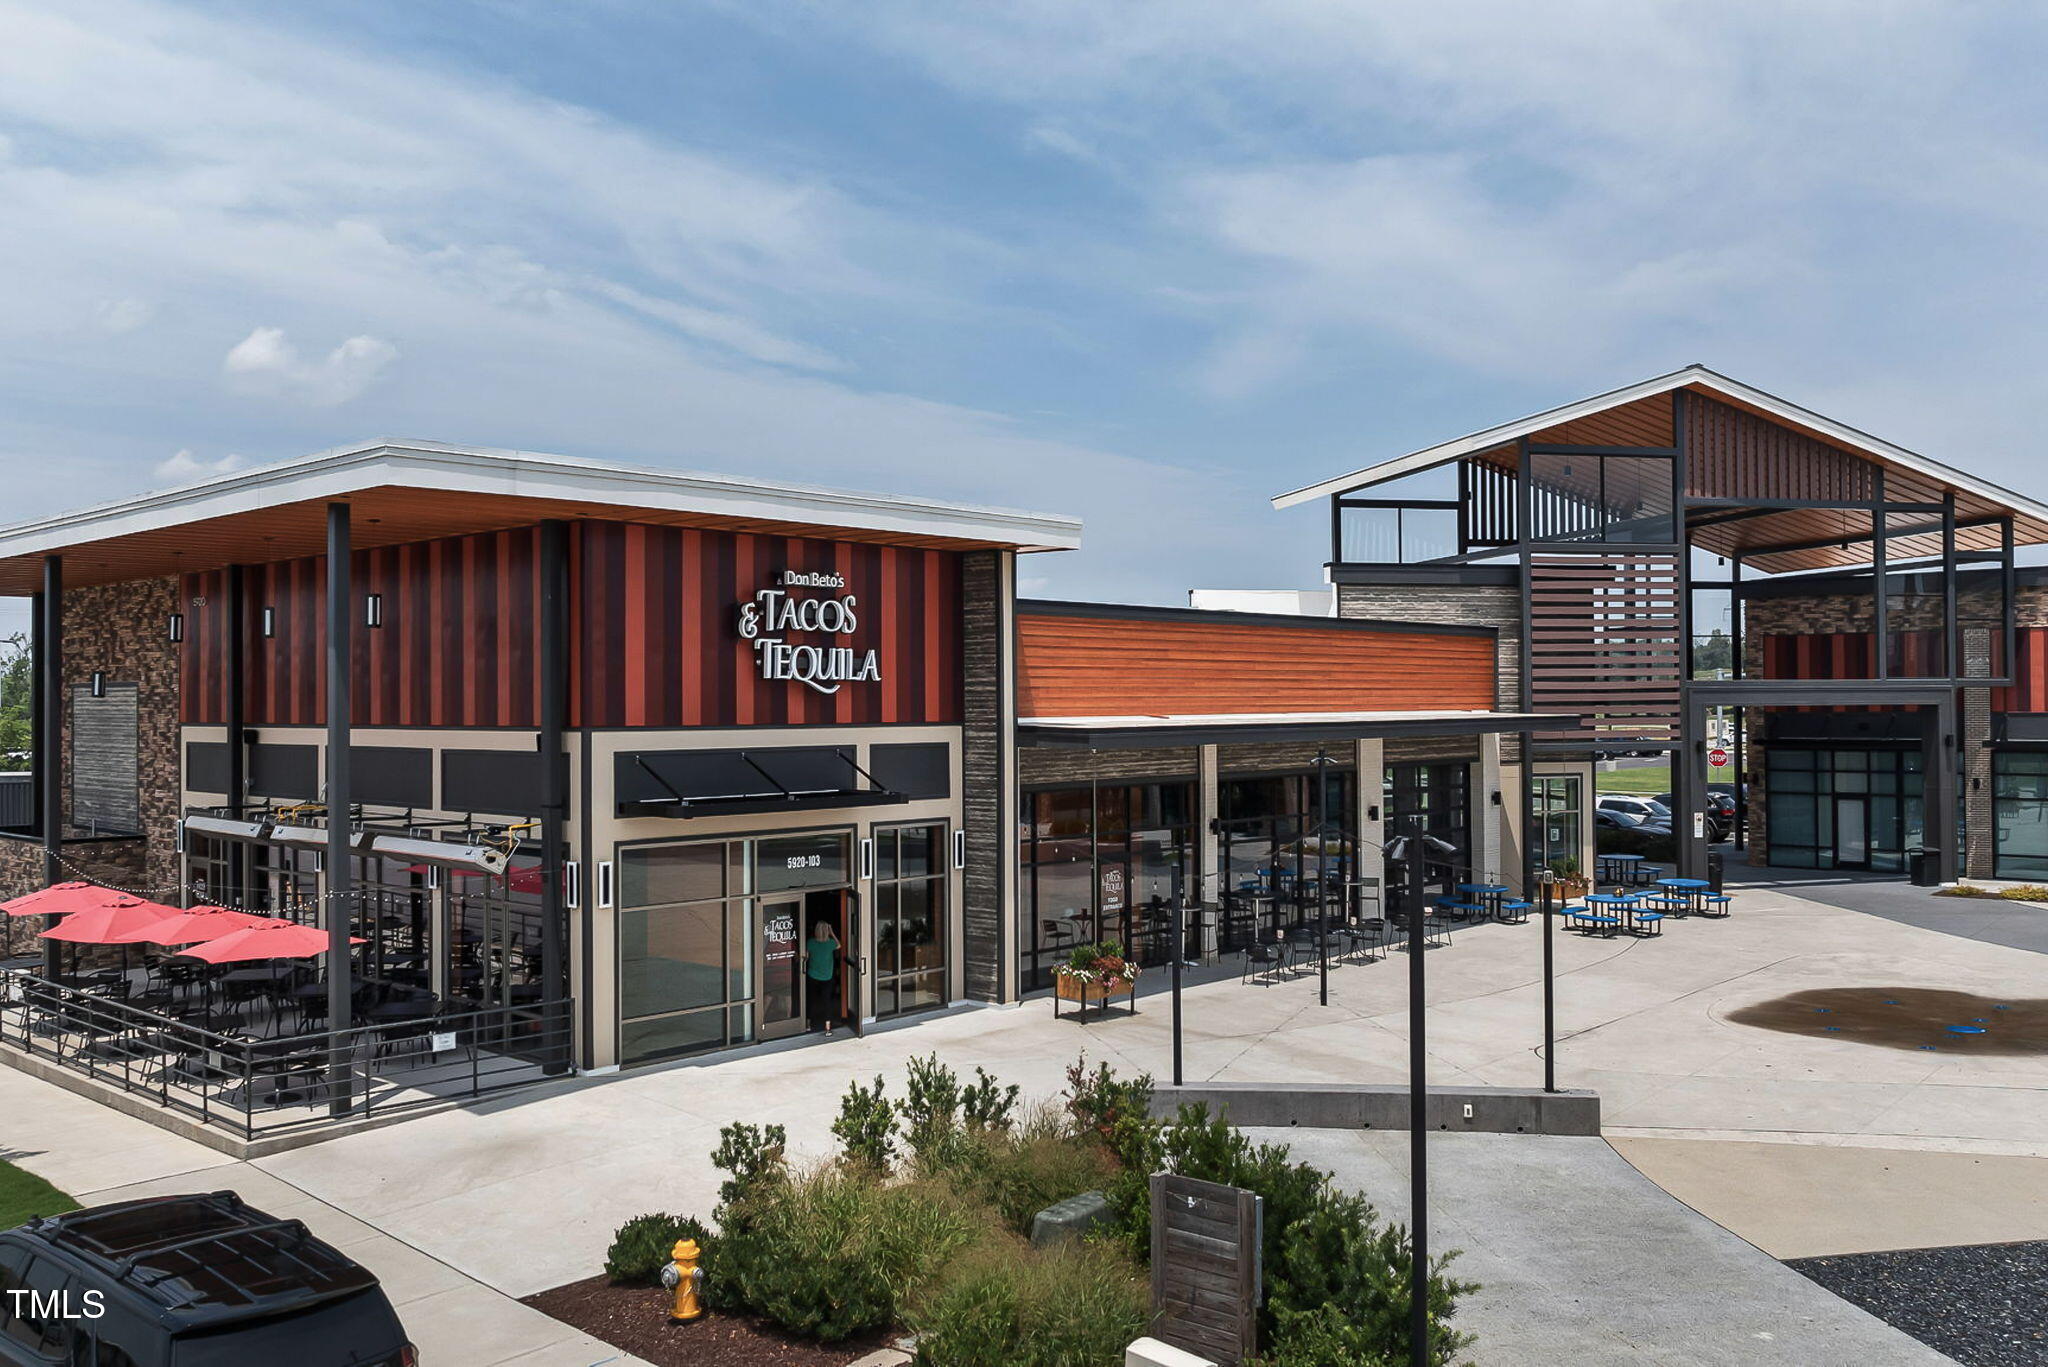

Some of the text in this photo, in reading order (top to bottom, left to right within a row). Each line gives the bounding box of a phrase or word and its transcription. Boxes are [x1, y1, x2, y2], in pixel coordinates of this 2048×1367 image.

[784, 570, 845, 588] Don Beto's
[738, 589, 857, 638] & TACOS
[754, 638, 882, 694] TEQUILA
[1709, 754, 1727, 762] STOP
[787, 854, 821, 869] 5920-103
[769, 919, 794, 931] TACOS
[769, 930, 797, 944] TEQUILA
